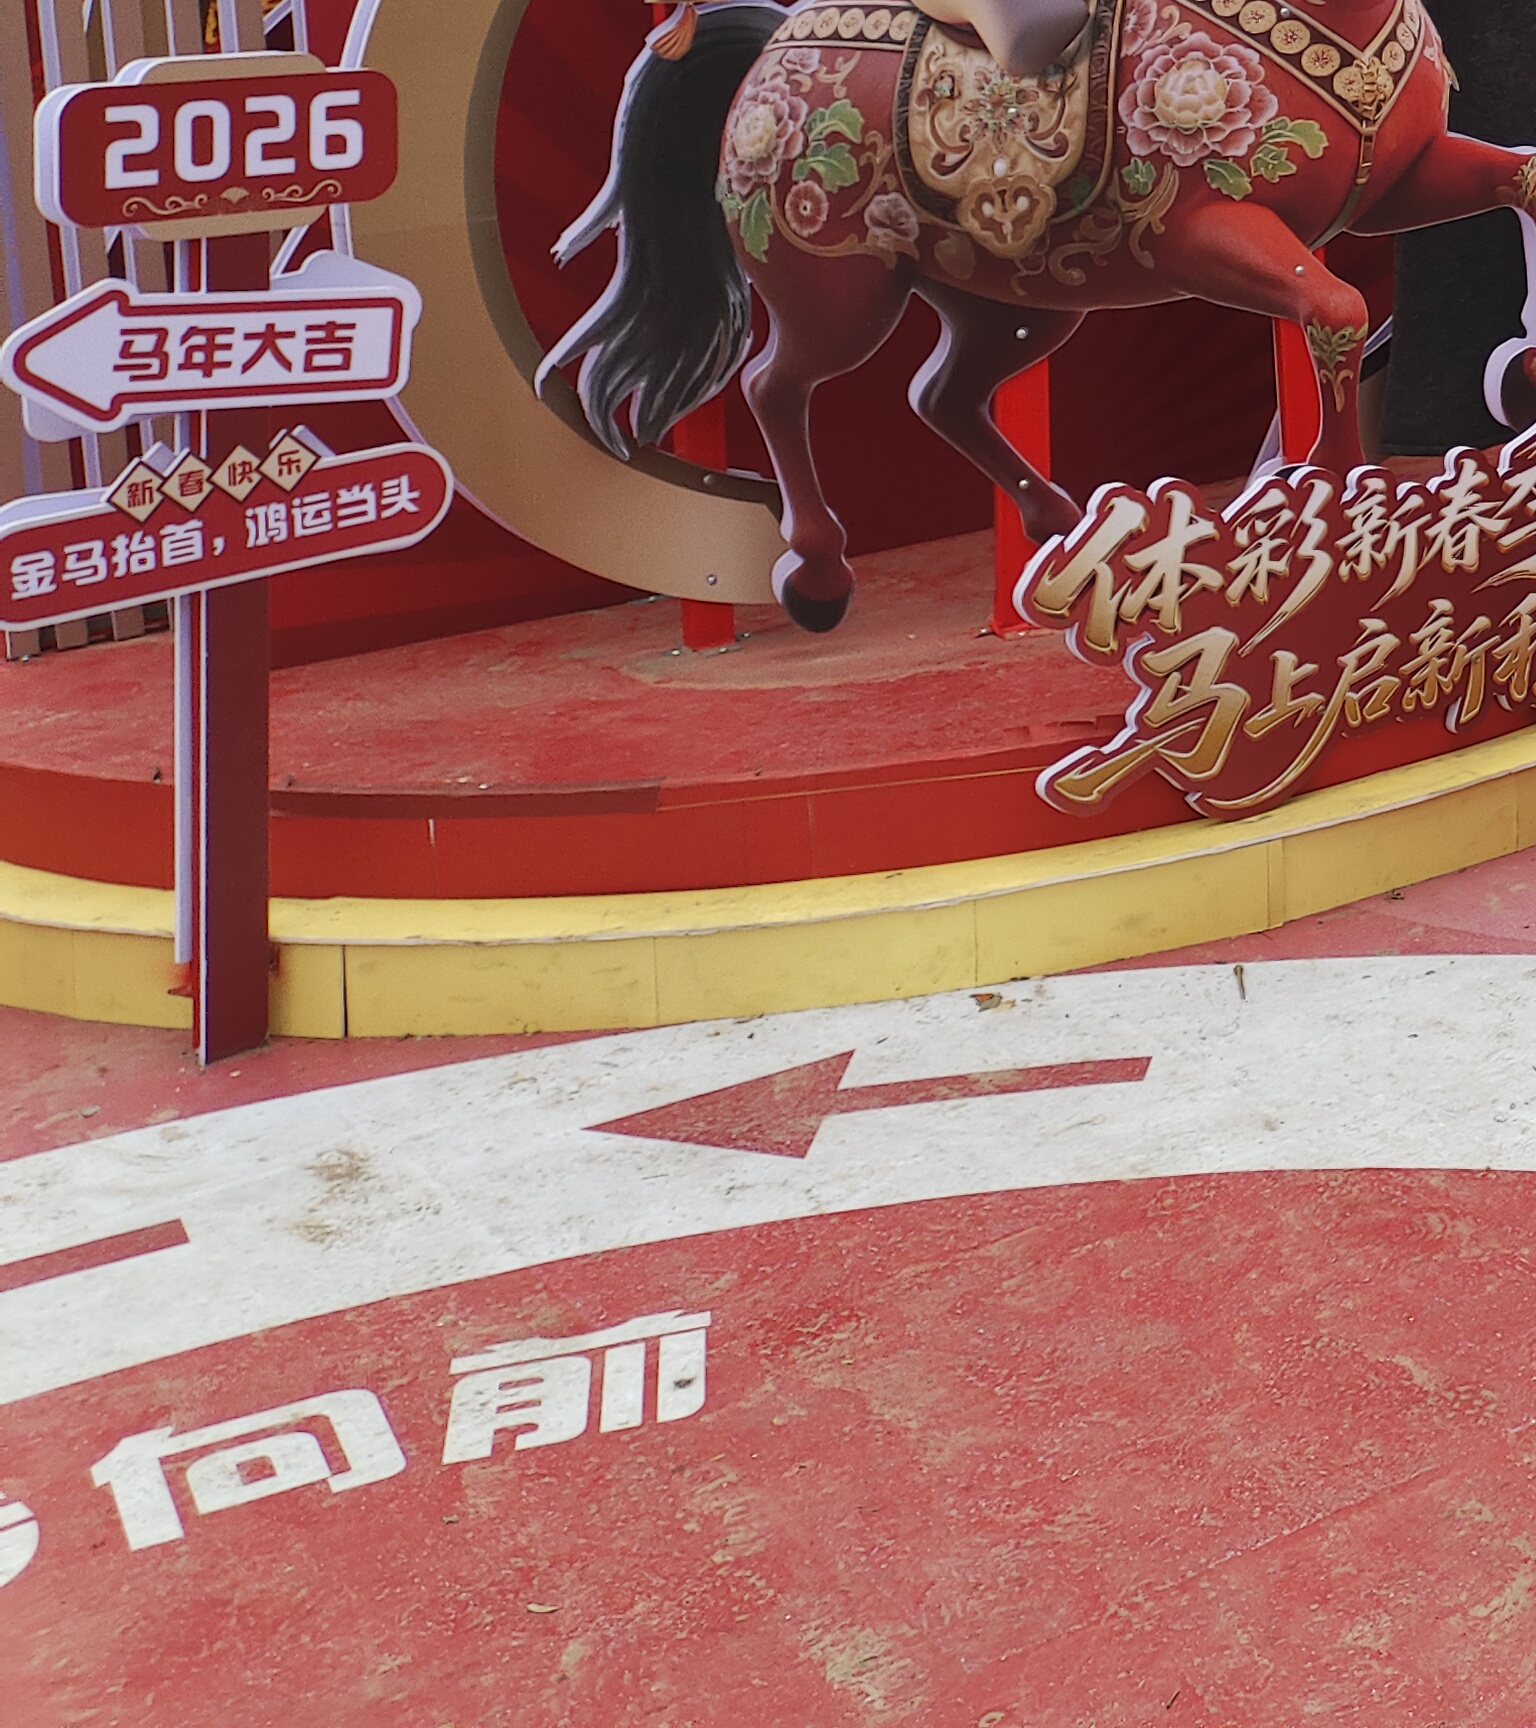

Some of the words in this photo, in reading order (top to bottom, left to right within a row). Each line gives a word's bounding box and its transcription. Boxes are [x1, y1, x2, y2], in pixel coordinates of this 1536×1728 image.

[104, 88, 364, 190] 2026
[113, 320, 357, 382] 马年大吉
[126, 447, 304, 509] 新春快乐
[0, 1309, 712, 1589] 向前
